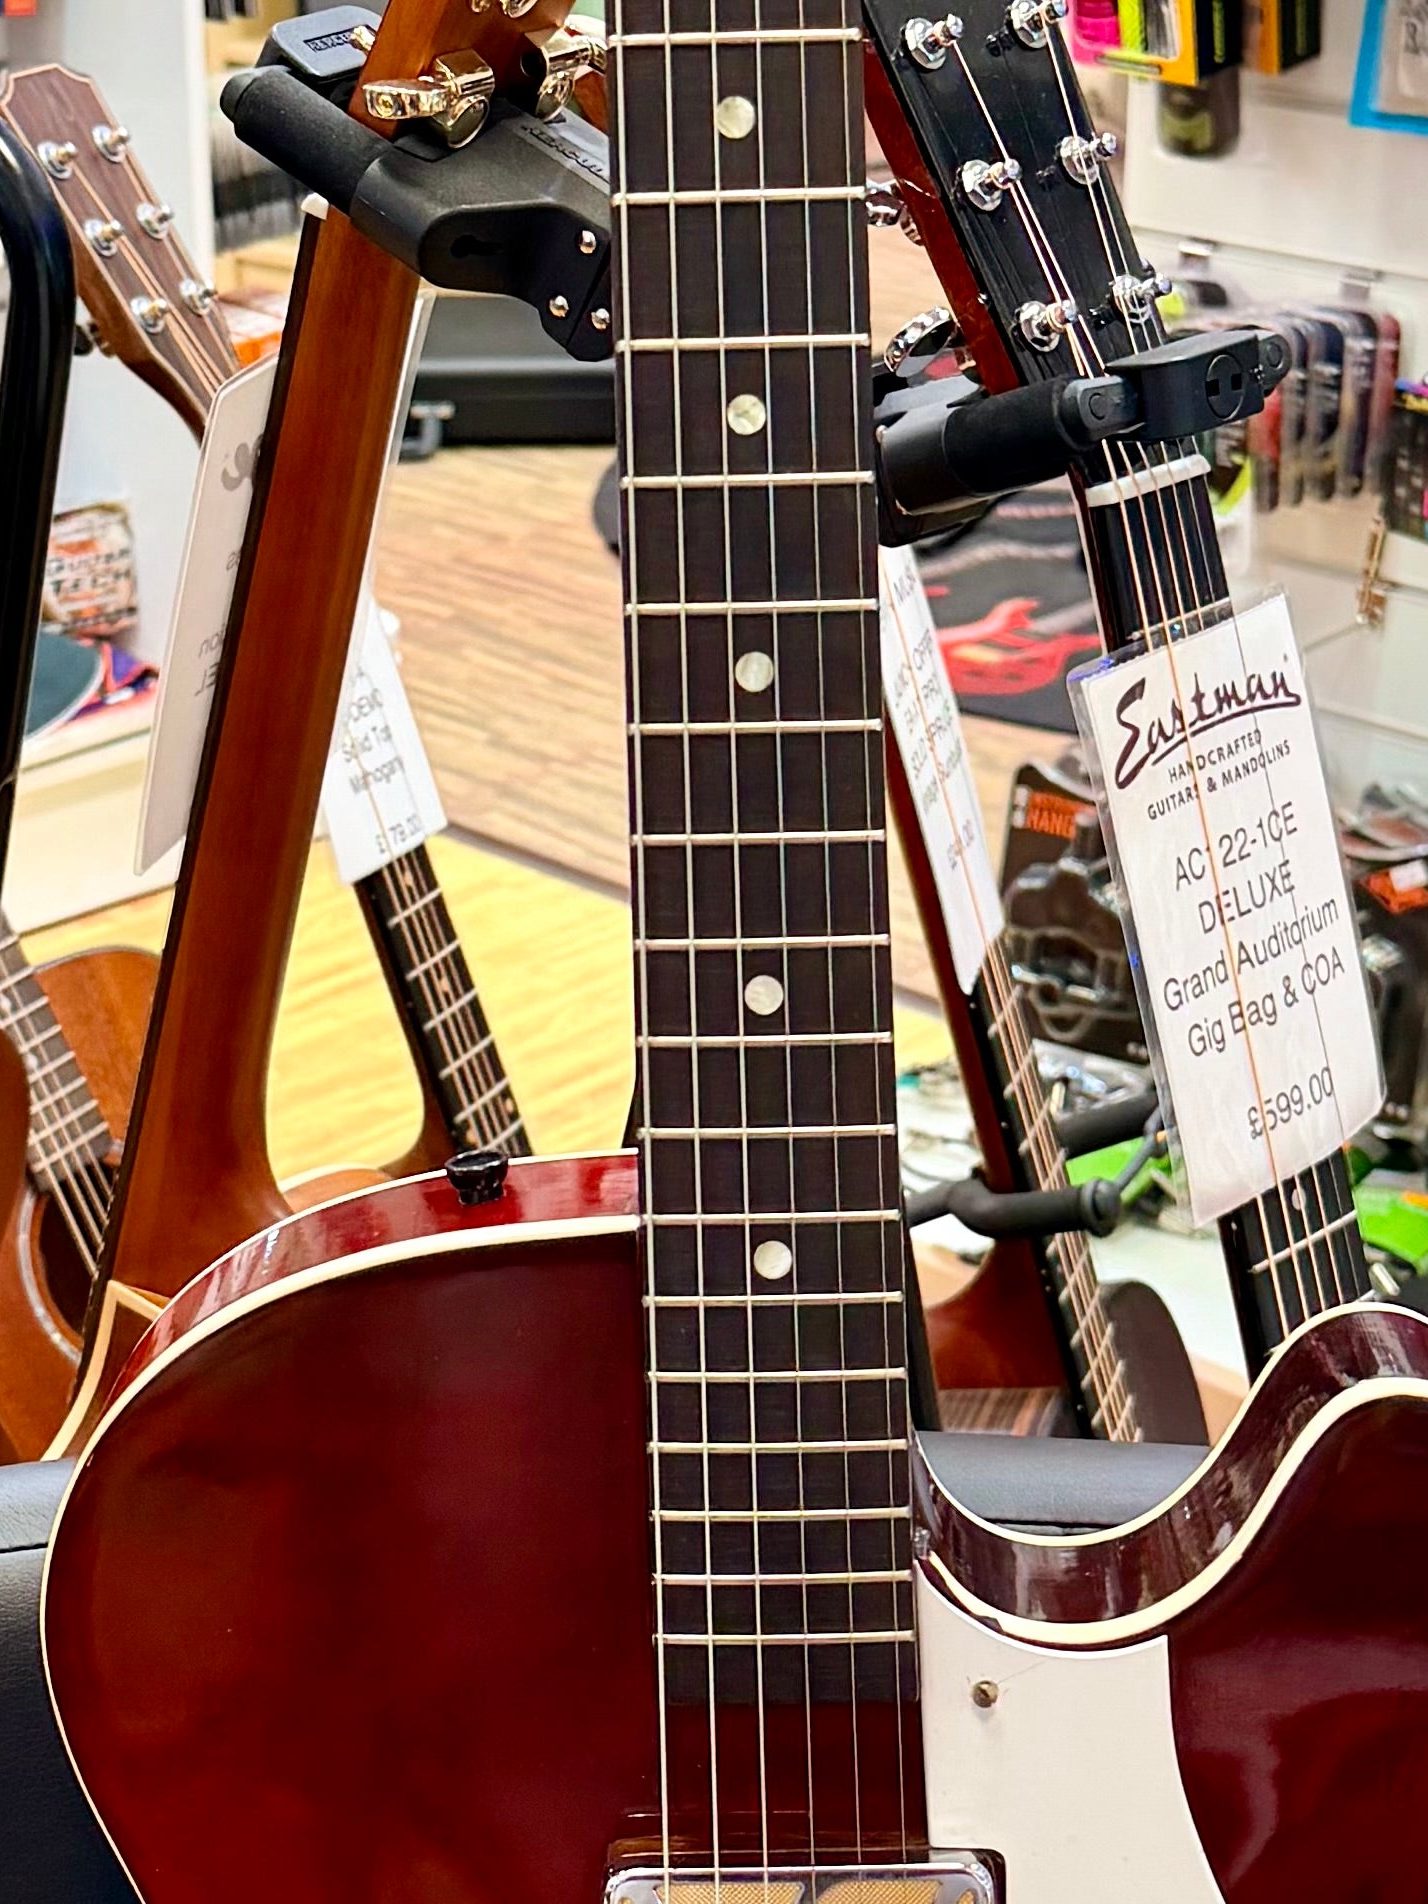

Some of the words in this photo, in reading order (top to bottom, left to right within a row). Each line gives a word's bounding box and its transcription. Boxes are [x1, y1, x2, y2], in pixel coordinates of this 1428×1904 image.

[1114, 668, 1301, 790] Eastman
[1168, 727, 1262, 784] HANDCRAFTED
[1147, 784, 1201, 821] GUITARS
[1206, 776, 1217, 794] &
[1222, 740, 1291, 789] MANDOLINS
[1197, 860, 1296, 935] DELUXE
[1163, 958, 1230, 1012] Grand
[1237, 897, 1340, 976] Auditorium
[1188, 1018, 1226, 1059] Gig
[1231, 991, 1278, 1036] Bag
[1282, 978, 1298, 1006] &
[1301, 947, 1346, 995] COA
[1247, 1067, 1335, 1140] £599.00
